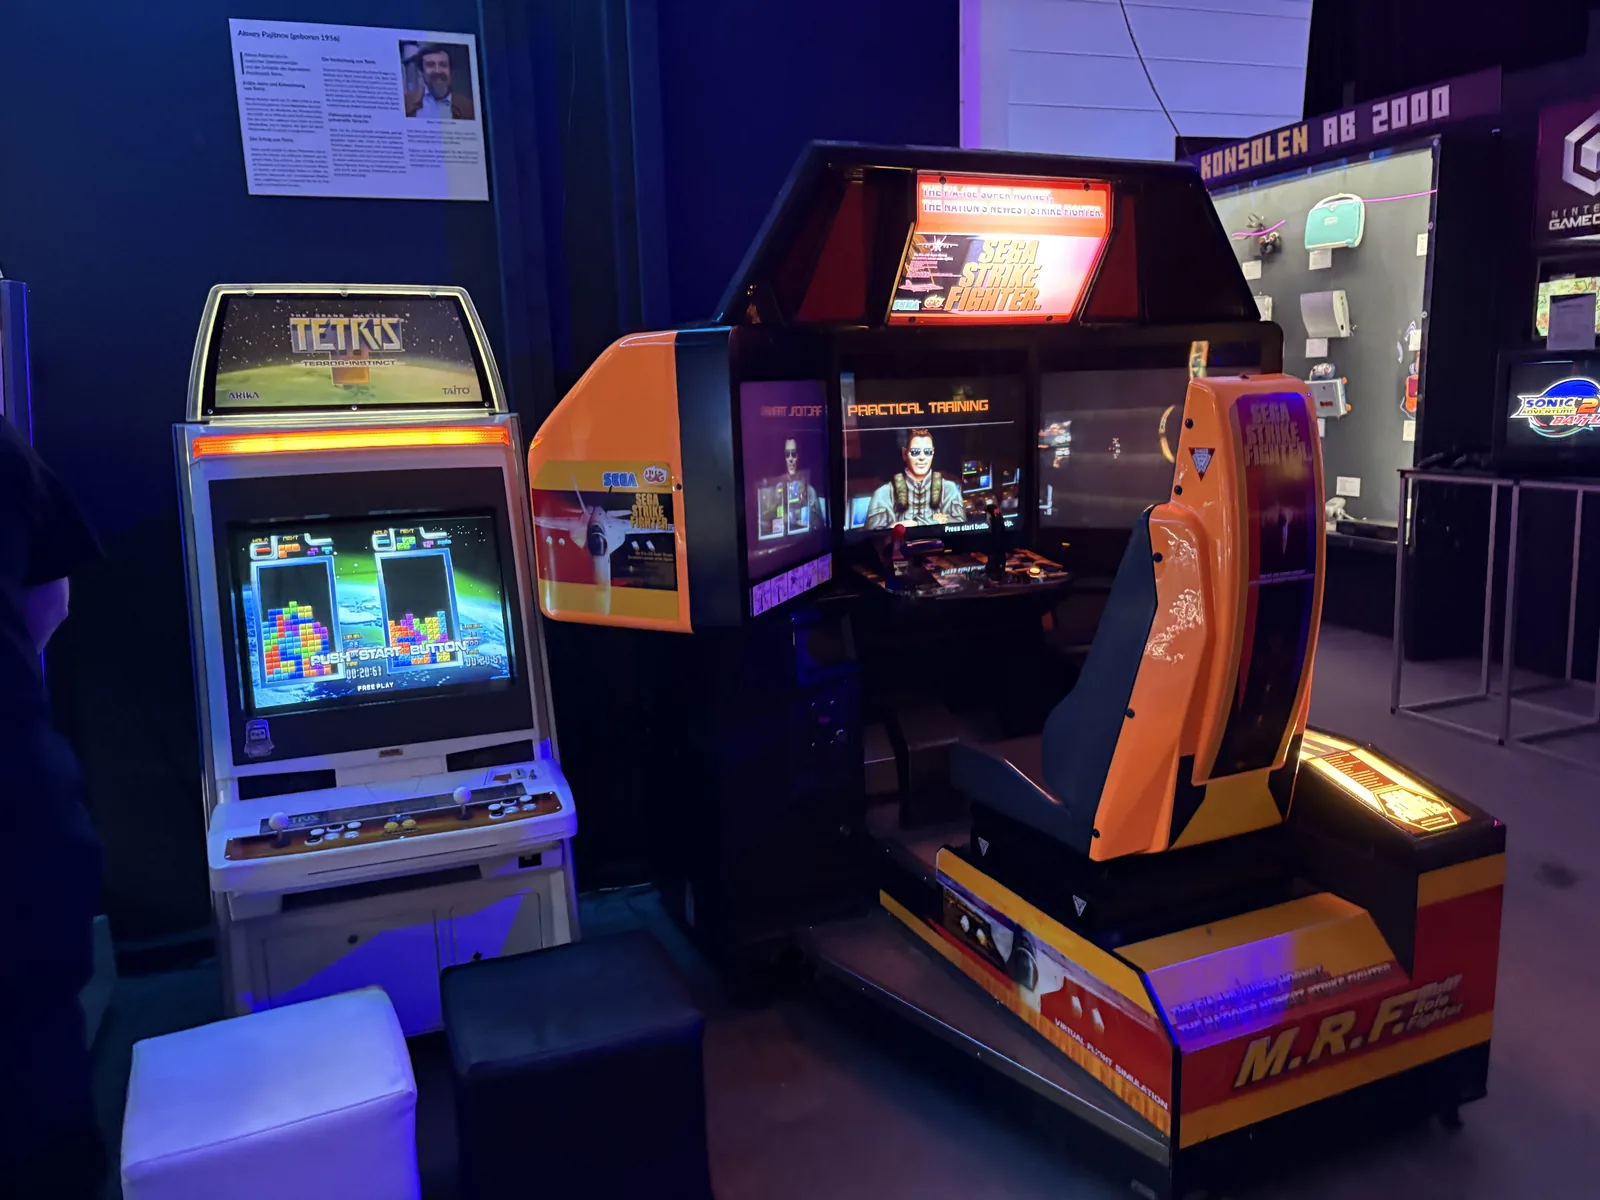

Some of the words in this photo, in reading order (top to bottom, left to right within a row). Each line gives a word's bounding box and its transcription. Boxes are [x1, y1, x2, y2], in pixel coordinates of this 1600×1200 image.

[1201, 124, 1308, 179] KONSOLEN
[1323, 110, 1356, 147] AB
[1372, 85, 1450, 135] 2000
[922, 185, 942, 198] THE
[922, 200, 942, 213] THE
[1029, 204, 1062, 217] STRIKE
[978, 239, 1040, 264] SEGA
[959, 264, 1042, 288] STRIKE
[892, 300, 920, 311] SEGA
[848, 403, 924, 417] PRACTICAL
[928, 400, 989, 413] TRAINING
[1251, 402, 1290, 424] SEGA
[1526, 399, 1575, 408] SONIC
[1577, 398, 1599, 414] 2
[603, 472, 639, 487] SEGA
[635, 493, 660, 507] SEGA
[631, 505, 664, 518] STRIKE
[945, 524, 960, 532] Press
[961, 523, 974, 531] start
[310, 652, 352, 666] PUSH
[358, 647, 402, 661] START
[410, 641, 468, 656] BUTTON
[357, 684, 376, 692] FREE
[376, 682, 394, 690] PLAY
[1055, 1016, 1086, 1047] VIRTUAL
[1115, 1063, 1168, 1111] SIMULATION
